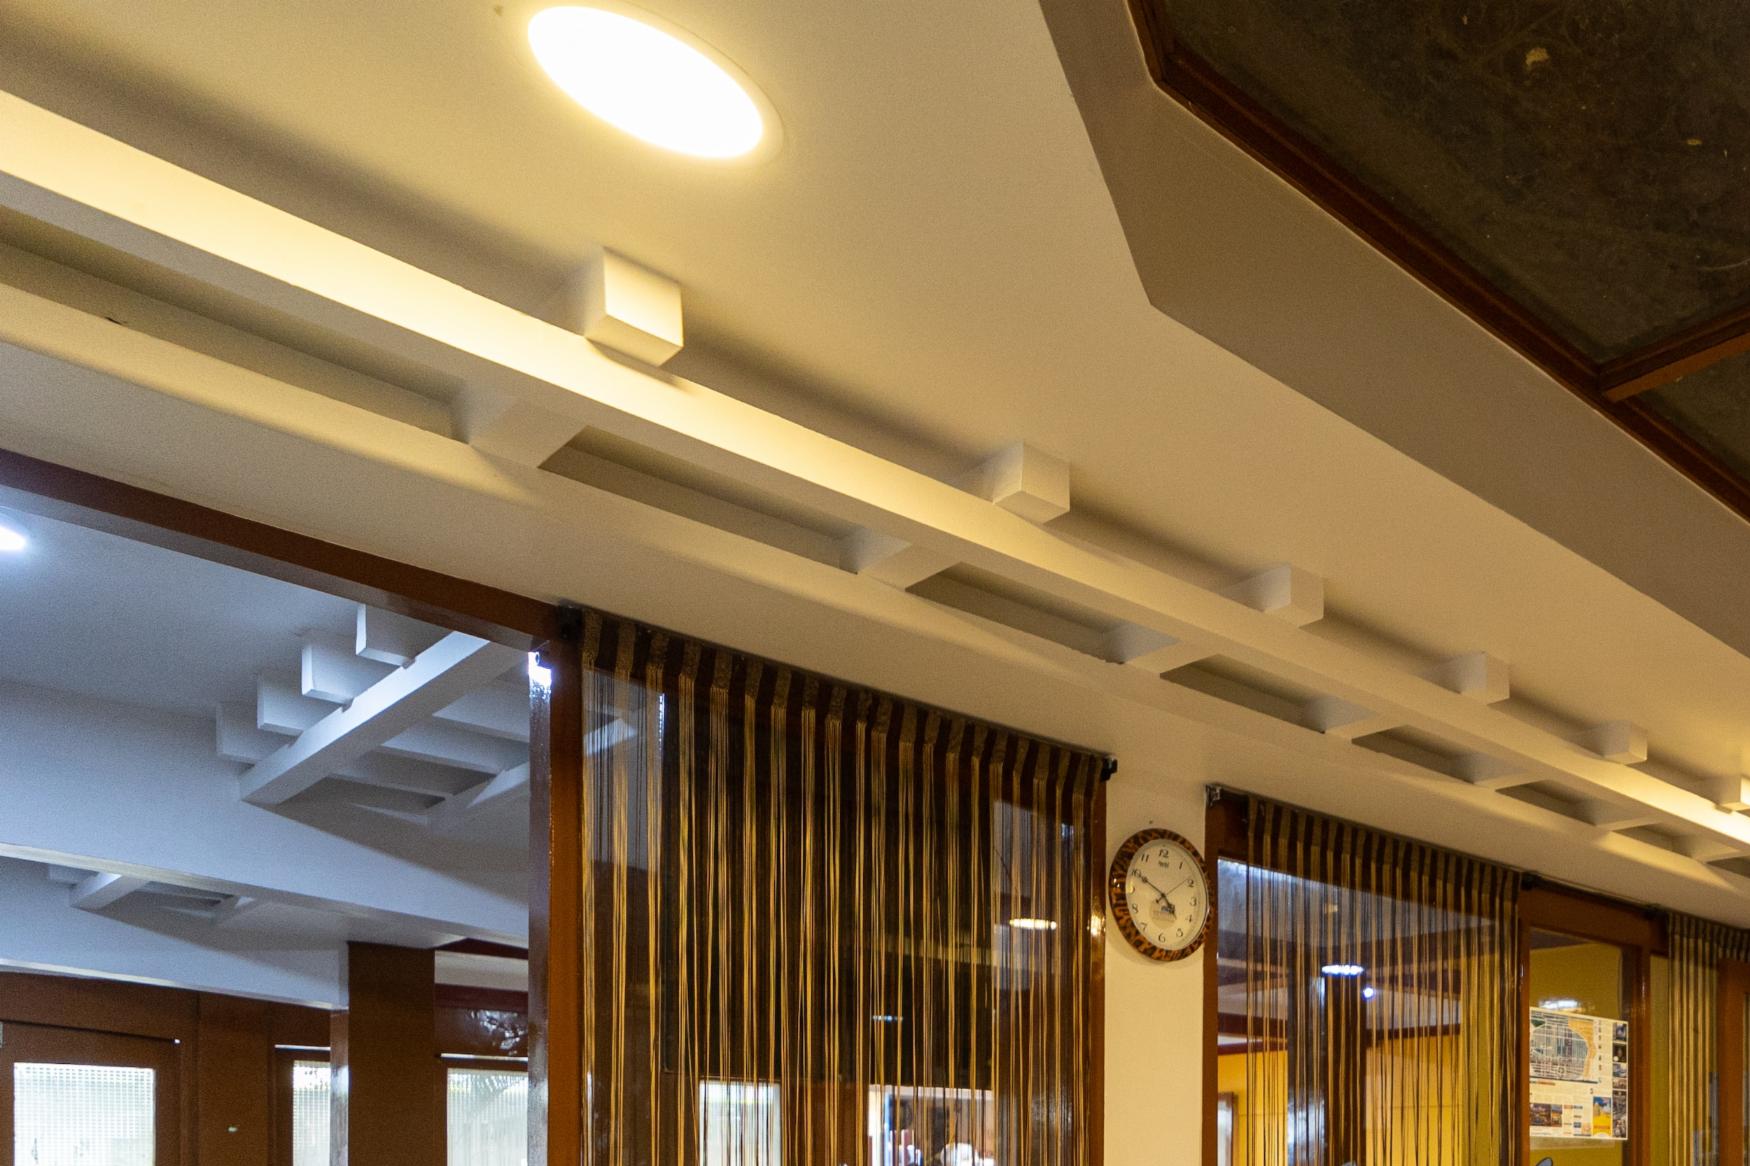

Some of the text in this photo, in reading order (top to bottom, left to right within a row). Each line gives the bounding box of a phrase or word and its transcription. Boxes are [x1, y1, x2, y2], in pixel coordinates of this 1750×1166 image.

[1141, 853, 1149, 863] 11
[1158, 849, 1169, 858] 12
[1187, 879, 1194, 888] 2
[1189, 897, 1197, 907] 3
[1131, 903, 1139, 914] 8
[1158, 933, 1166, 943] 6
